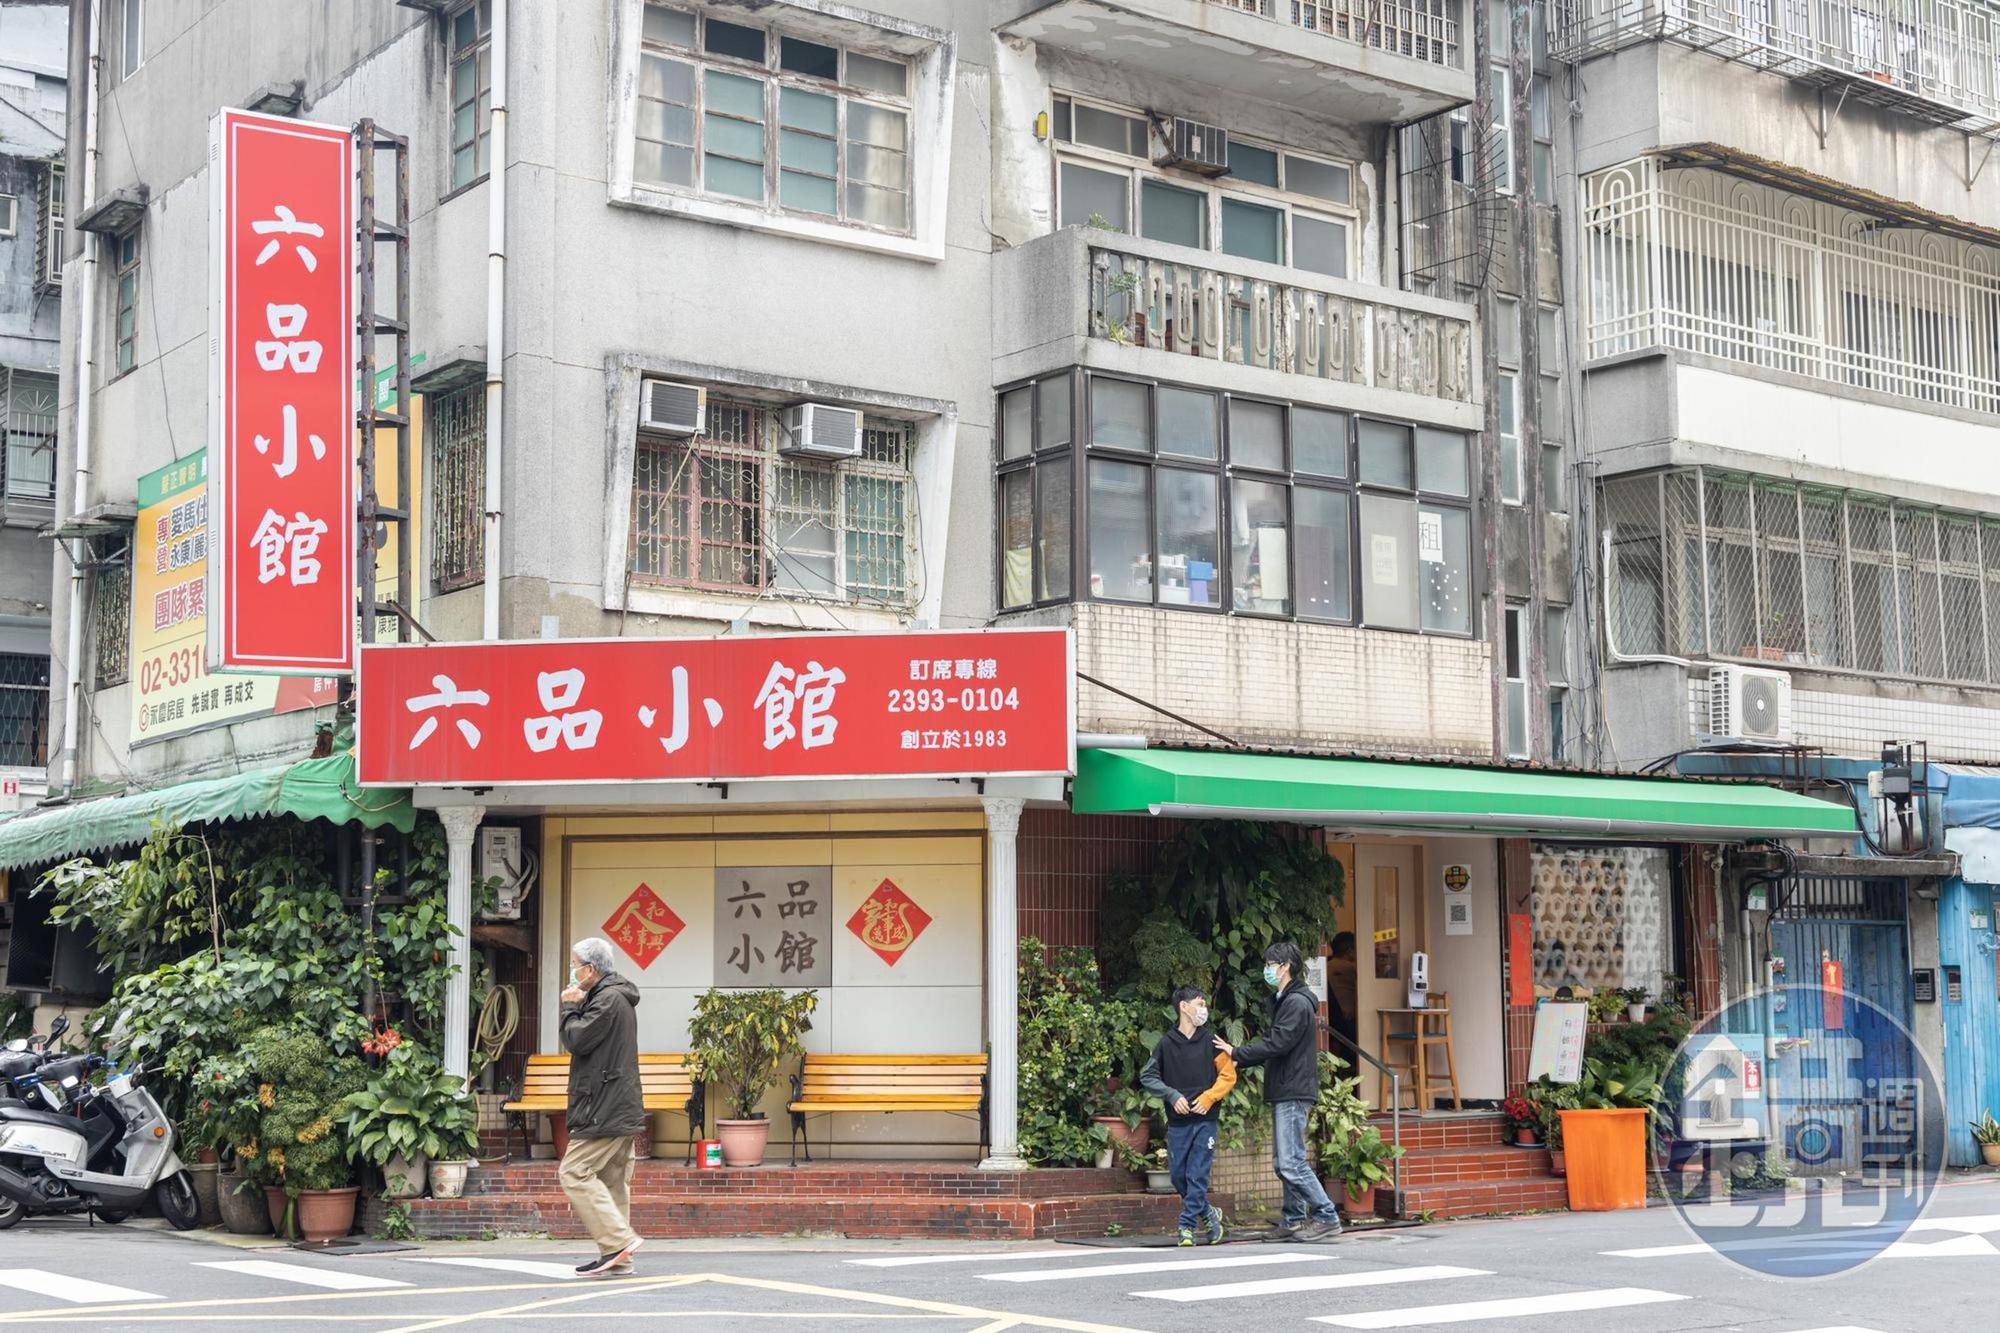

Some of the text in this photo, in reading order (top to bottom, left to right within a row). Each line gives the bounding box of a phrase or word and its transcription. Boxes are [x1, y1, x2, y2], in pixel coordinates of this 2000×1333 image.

[250, 204, 328, 586] 六品小館
[156, 516, 169, 573] 專營
[170, 534, 208, 568] 永康/麗
[1417, 521, 1441, 550] 租
[155, 579, 207, 630] 團隊累
[909, 658, 998, 681] 訂席專線
[191, 687, 219, 714] 先誠實
[224, 679, 254, 705] 再成交
[406, 660, 847, 754] 六品小館
[887, 687, 1020, 712] 2393-0104
[900, 729, 1007, 749] 創立於1983
[727, 880, 818, 919] 六品
[727, 930, 818, 974] 小館
